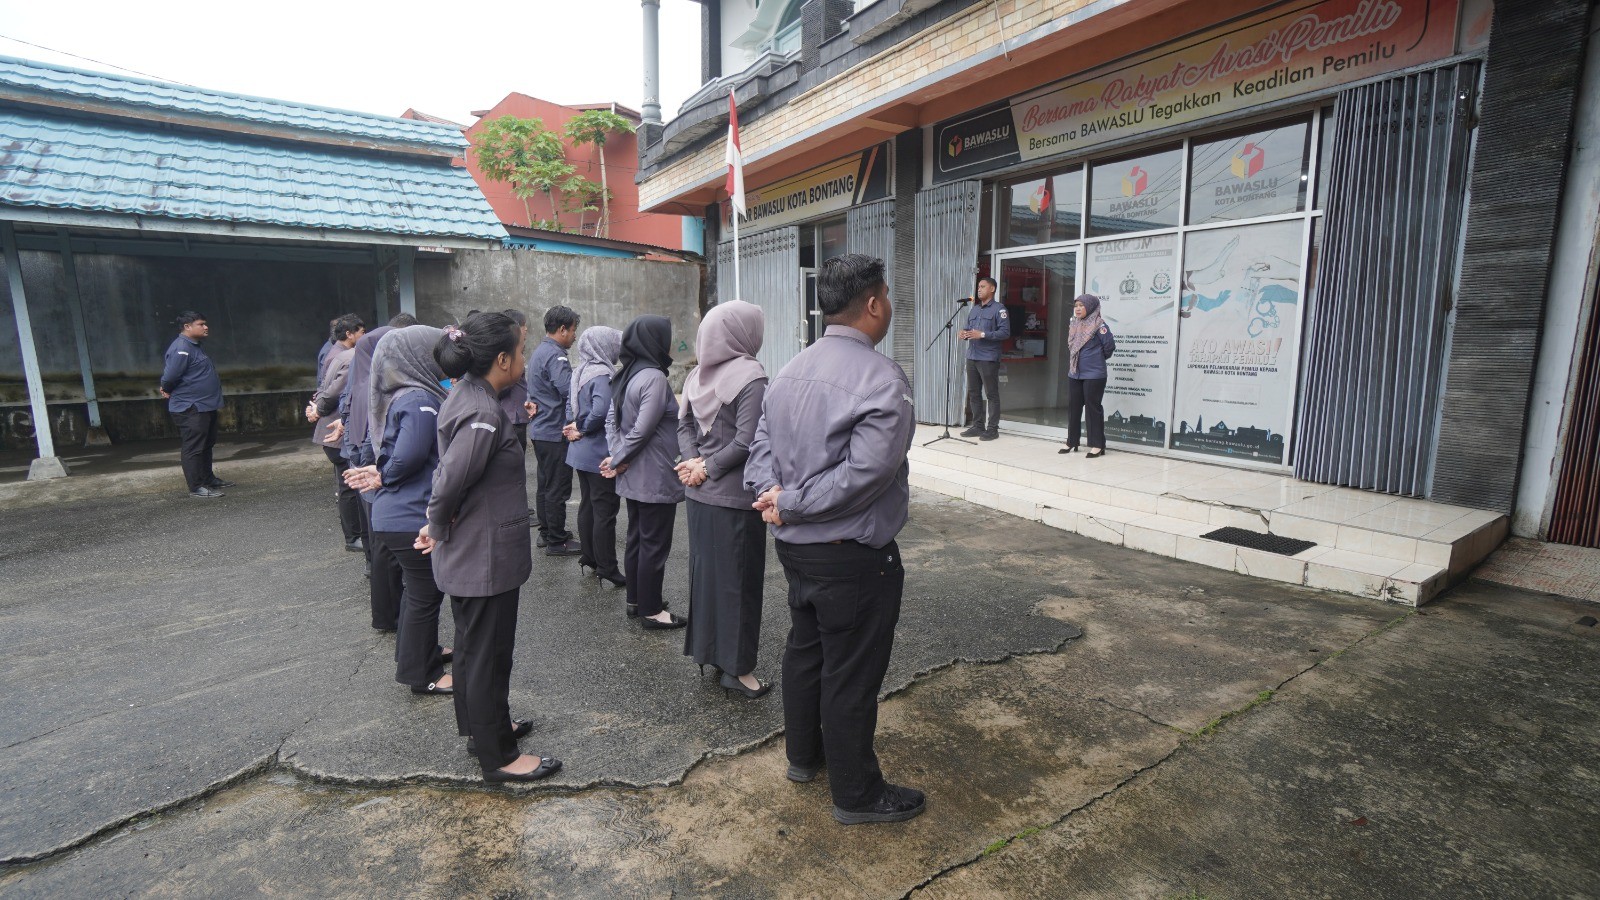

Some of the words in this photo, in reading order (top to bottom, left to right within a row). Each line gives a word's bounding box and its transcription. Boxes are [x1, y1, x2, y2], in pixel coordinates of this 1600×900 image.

[1021, 96, 1098, 133] Bersama
[1101, 62, 1182, 110] Rakyat
[1183, 32, 1277, 86] Awasi
[1279, 1, 1400, 61] Pemilu
[1029, 129, 1076, 151] Bersama
[1080, 109, 1145, 137] BAWASLU
[1149, 91, 1222, 121] Tegakkan
[1233, 65, 1314, 98] Keadilan
[1322, 41, 1396, 75] Pemilu
[964, 125, 1010, 149] BAWASLU
[1215, 177, 1278, 198] BAWASLU
[753, 200, 786, 220] BAWASLU
[787, 190, 808, 211] KOTA
[809, 174, 854, 204] BONTANG
[1109, 197, 1158, 213] BAWASLU
[1214, 195, 1236, 206] KOTA
[1237, 191, 1277, 203] BONTANG
[1126, 208, 1158, 218] BONTANG
[1189, 339, 1218, 354] AYO
[1189, 353, 1230, 363] TAHAPAN
[1233, 355, 1269, 365] PEMILU
